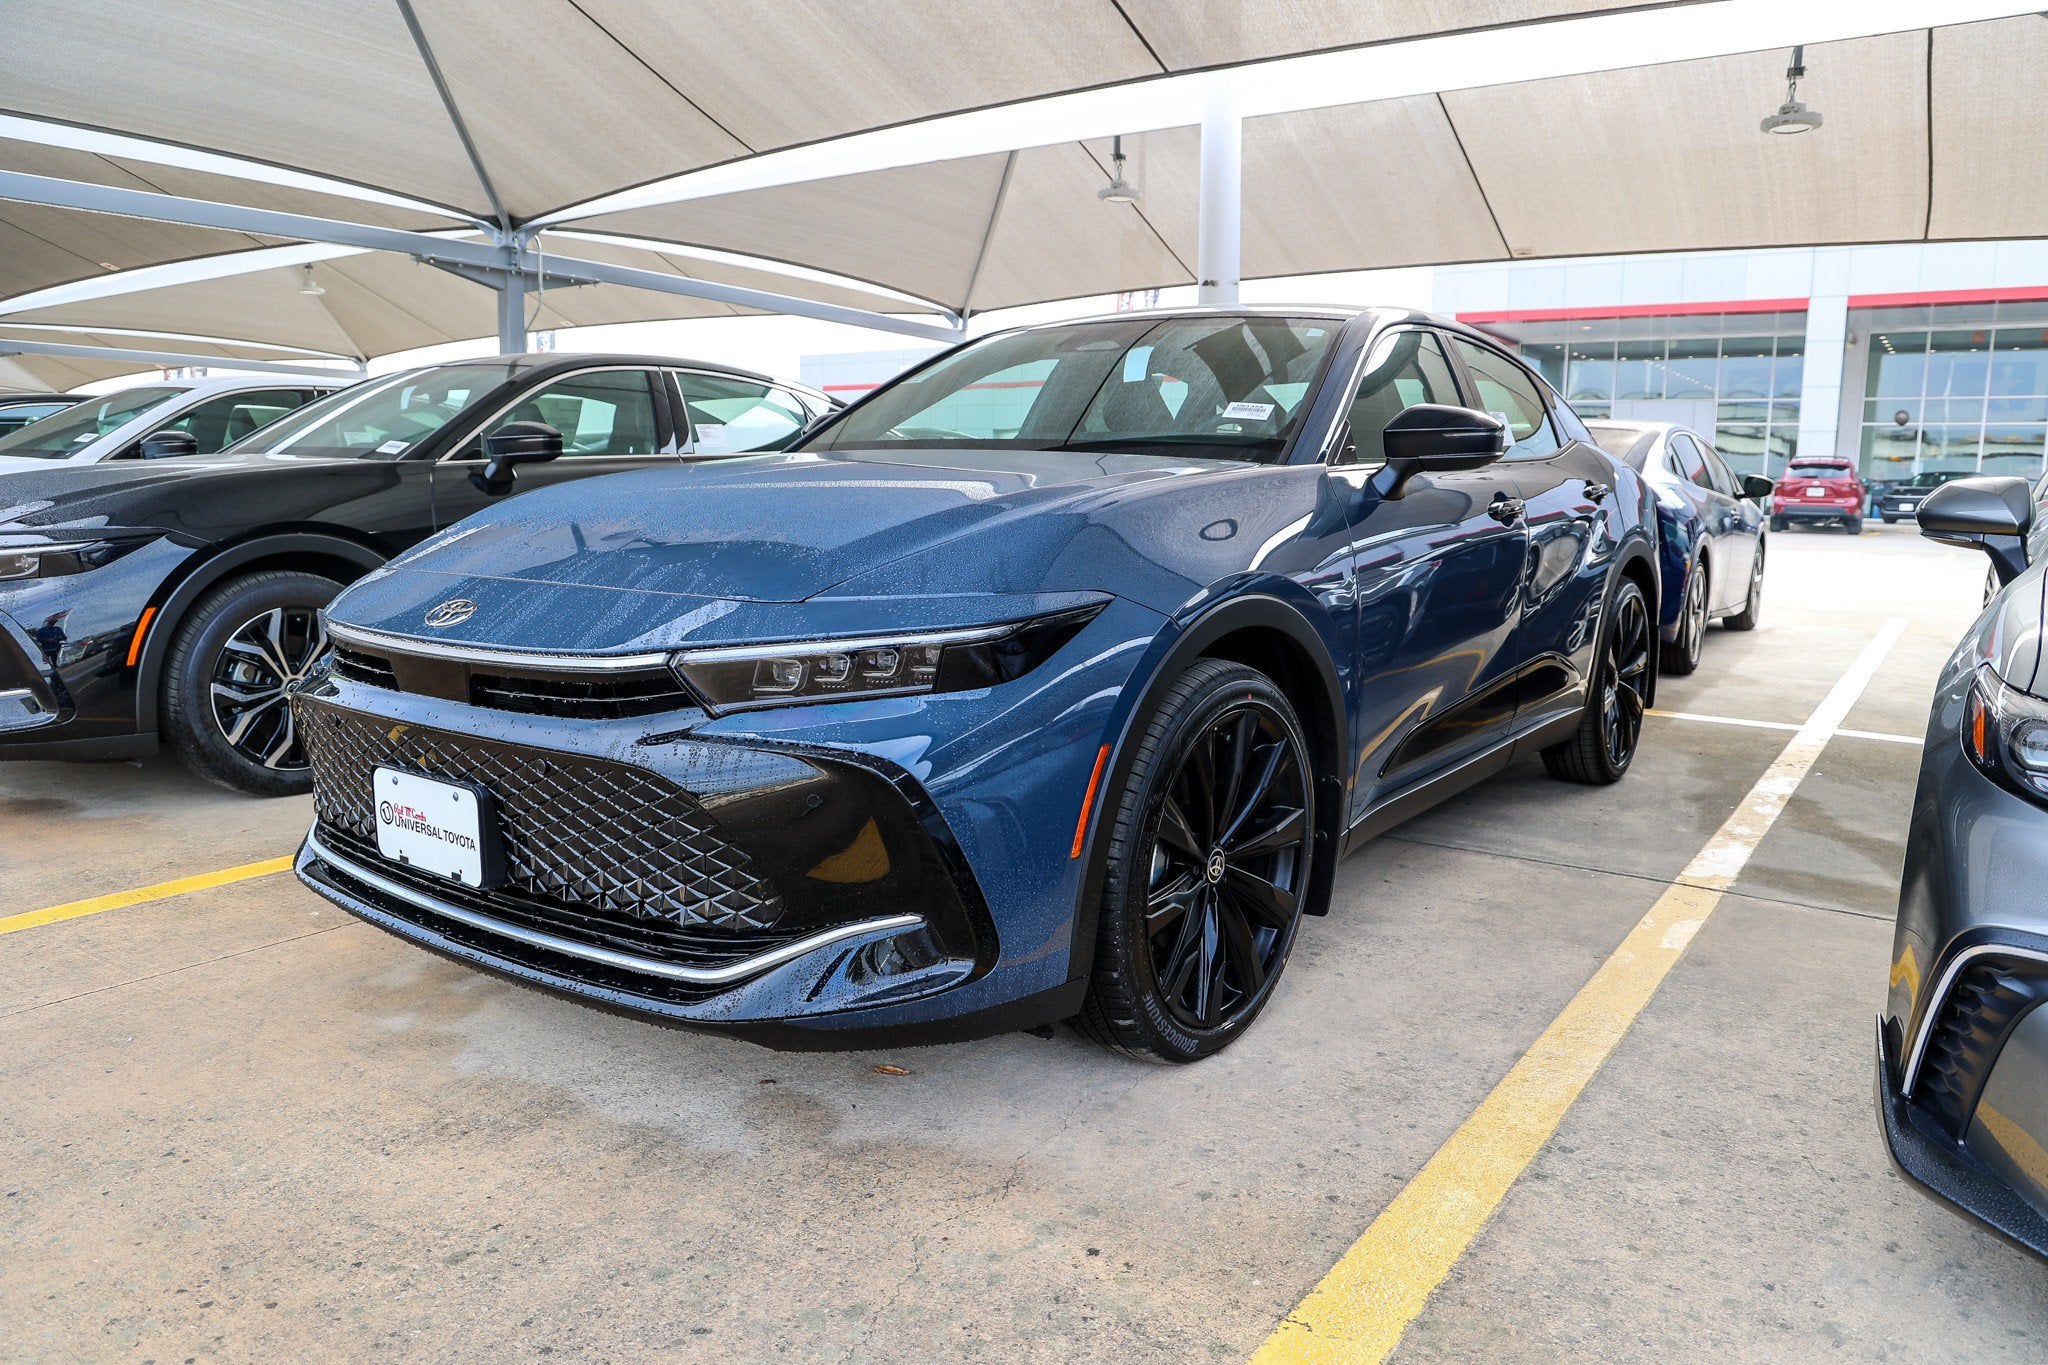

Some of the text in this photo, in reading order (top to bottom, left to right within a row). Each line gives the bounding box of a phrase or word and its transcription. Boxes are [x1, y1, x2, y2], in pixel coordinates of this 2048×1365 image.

[395, 815, 476, 851] UNIVERSAL TOYOTA
[1142, 991, 1199, 1053] BRIDGESTONE
